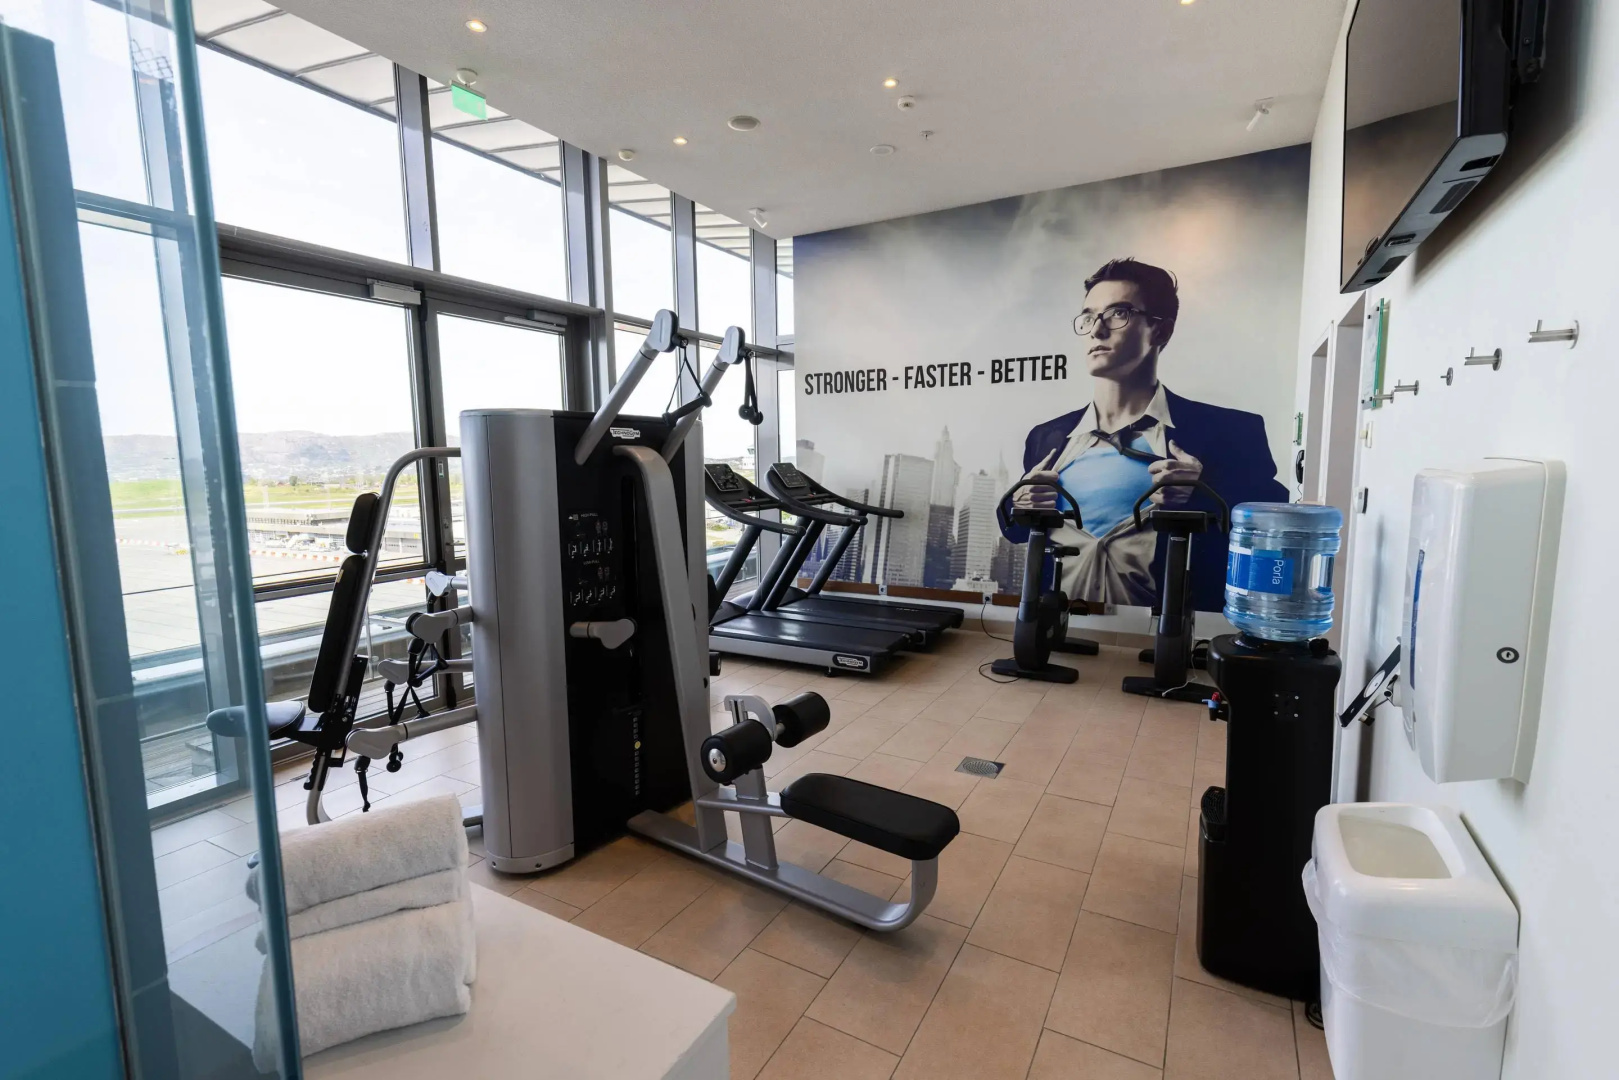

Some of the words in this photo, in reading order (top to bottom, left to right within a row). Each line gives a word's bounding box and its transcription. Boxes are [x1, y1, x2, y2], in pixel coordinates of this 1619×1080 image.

[804, 368, 888, 396] STRONGER
[904, 361, 972, 390] FASTER
[990, 354, 1068, 384] BETTER
[1272, 559, 1284, 585] Porla
